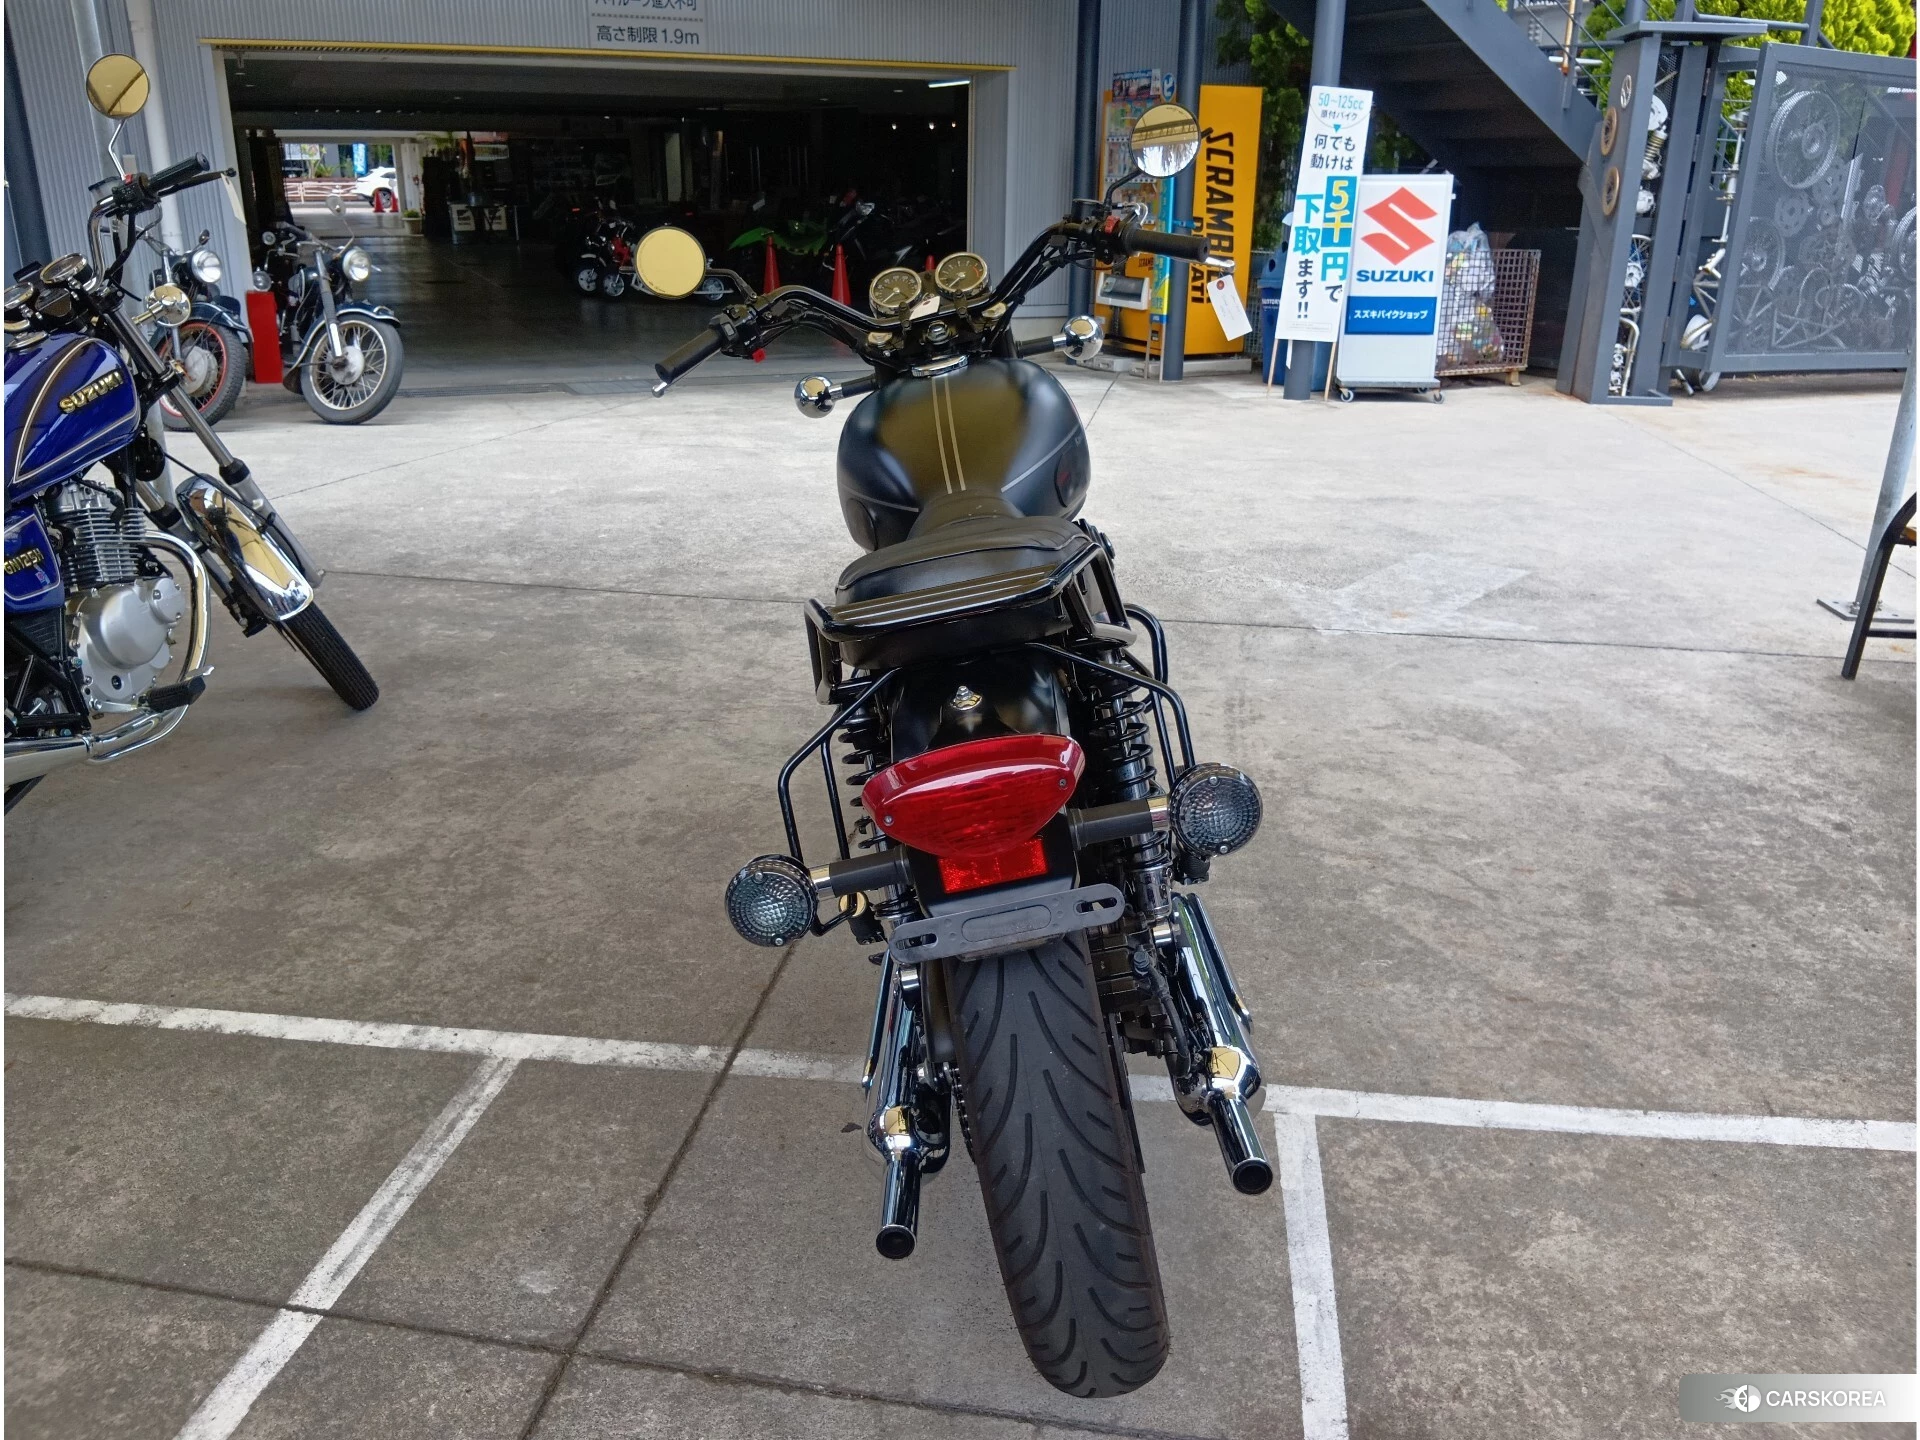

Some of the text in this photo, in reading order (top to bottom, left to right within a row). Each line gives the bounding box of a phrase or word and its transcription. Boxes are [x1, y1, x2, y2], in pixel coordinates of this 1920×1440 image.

[1314, 134, 1356, 152] 何でも
[1310, 153, 1355, 171] 動けば
[1206, 131, 1234, 303] SCRAMB
[1191, 216, 1205, 304] DATI
[1356, 270, 1434, 282] SUZUKI
[1354, 309, 1428, 320] スズキバイクショップ
[60, 371, 123, 413] SUZUKI
[4, 548, 45, 575] GN125H
